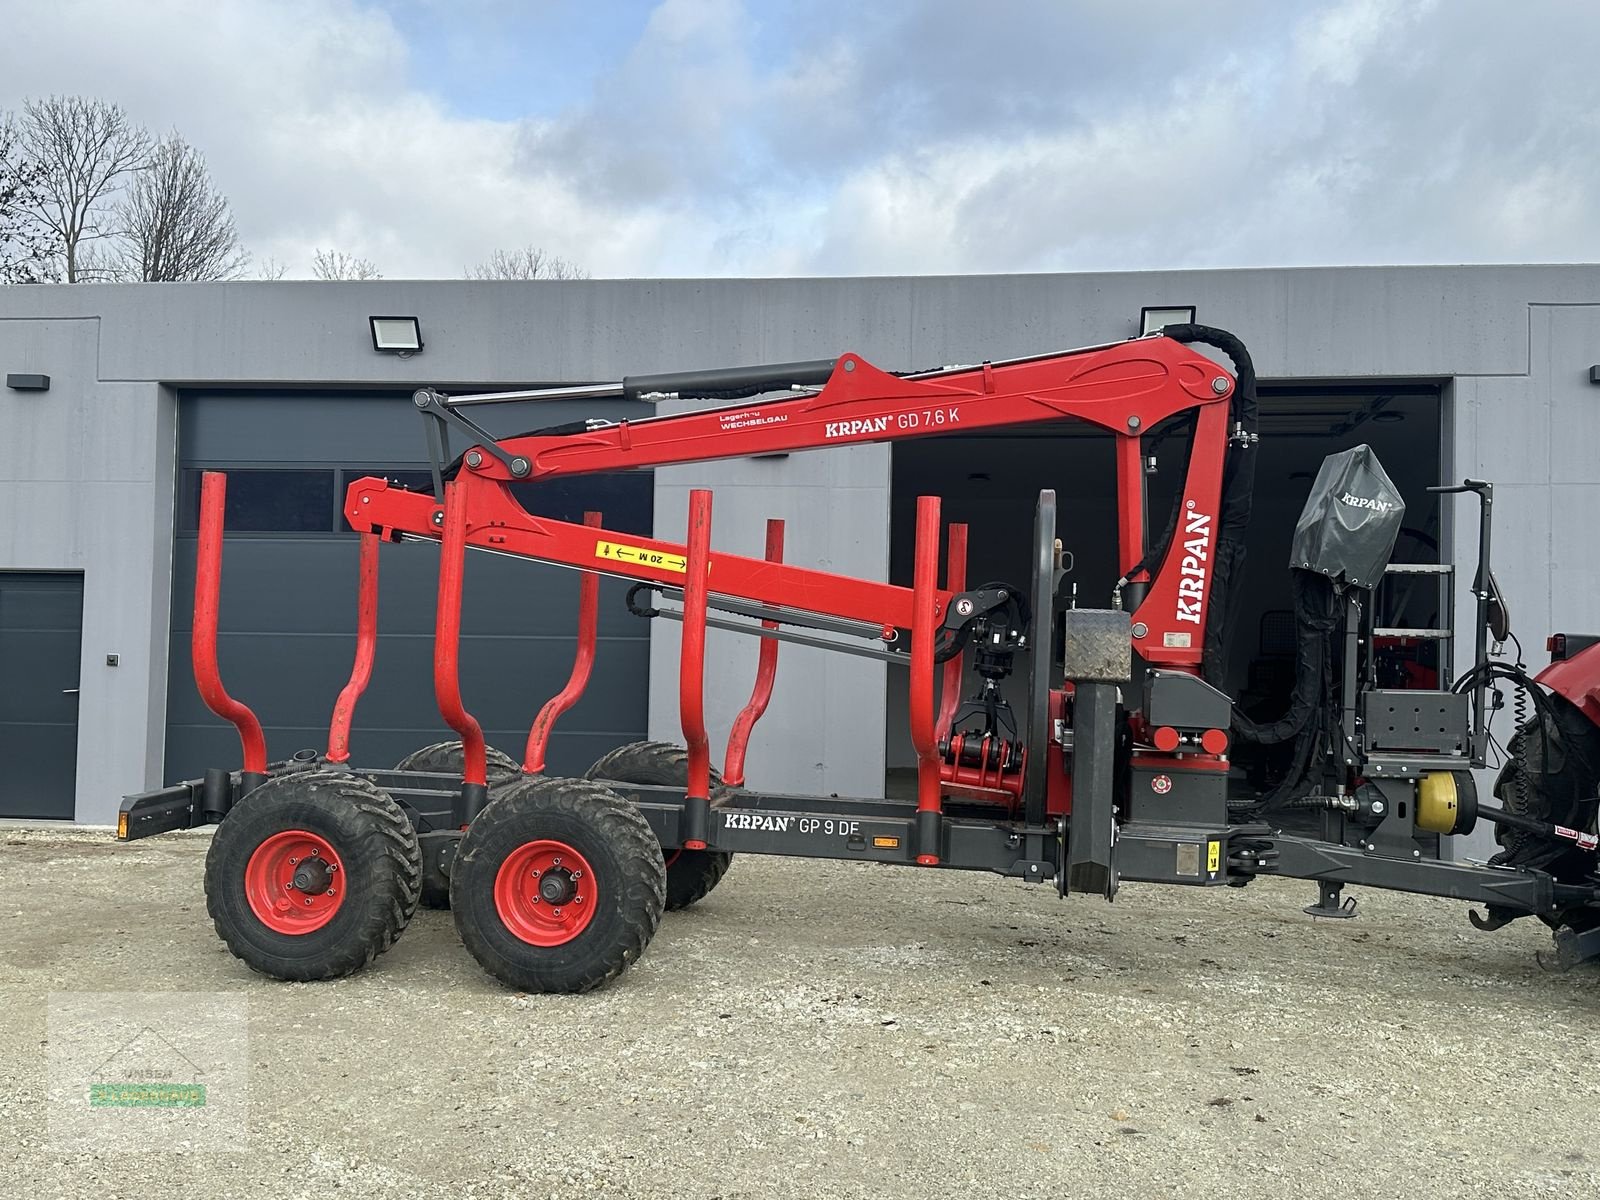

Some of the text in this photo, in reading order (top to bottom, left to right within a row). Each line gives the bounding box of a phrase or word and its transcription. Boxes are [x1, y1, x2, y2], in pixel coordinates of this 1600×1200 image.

[721, 414, 788, 430] WECHSELGAU
[897, 413, 919, 429] GD
[922, 409, 945, 427] 7,6
[949, 407, 960, 423] K
[639, 552, 663, 564] 20 M
[799, 818, 820, 834] GP
[824, 820, 834, 835] 9
